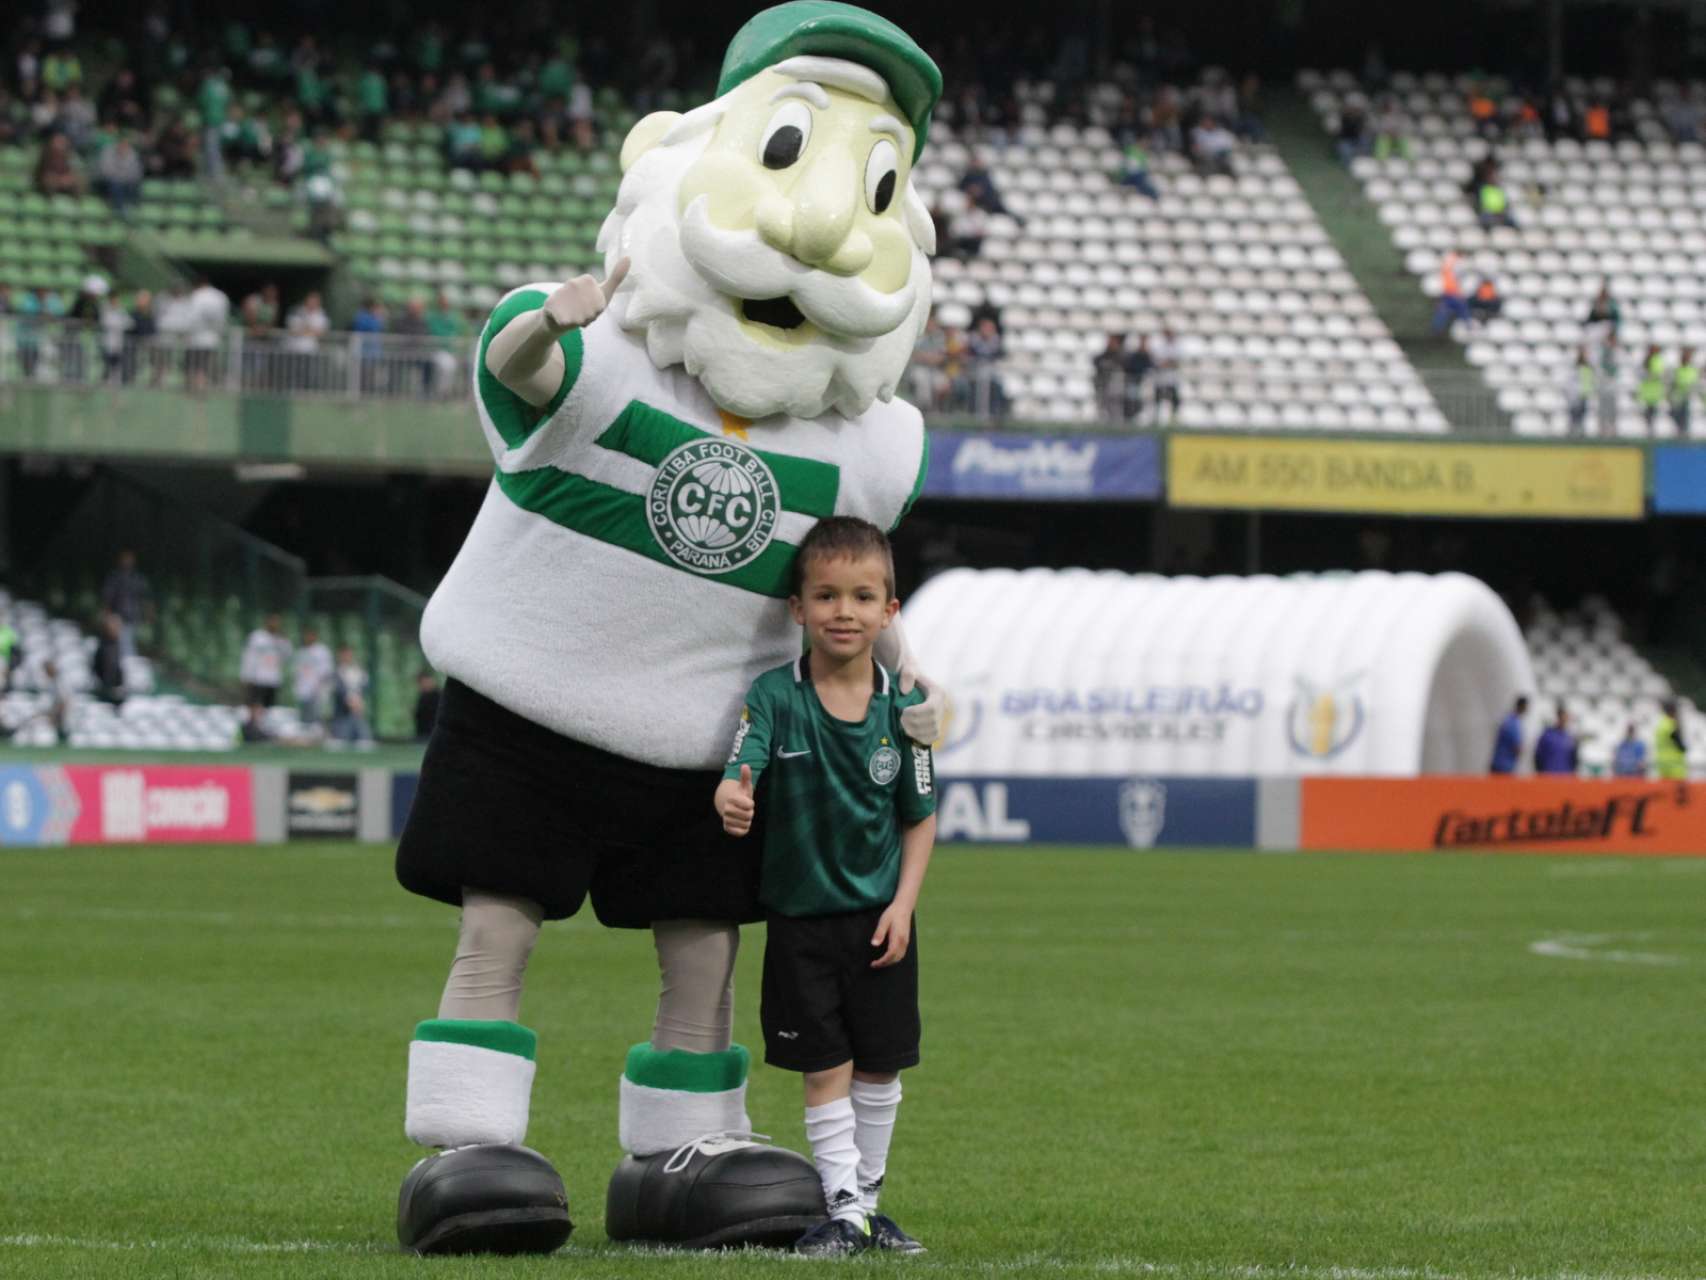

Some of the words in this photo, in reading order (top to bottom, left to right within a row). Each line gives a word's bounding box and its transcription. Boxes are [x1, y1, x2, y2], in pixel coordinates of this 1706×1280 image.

[699, 443, 746, 463] FOOT
[1195, 451, 1247, 484] AM
[1322, 455, 1447, 495] BANDA
[652, 450, 697, 526] CORITIBA
[745, 459, 773, 503] BALL
[677, 481, 752, 528] CFC
[746, 509, 775, 552] CLUB
[1000, 678, 1265, 718] BRASILEIRÃO
